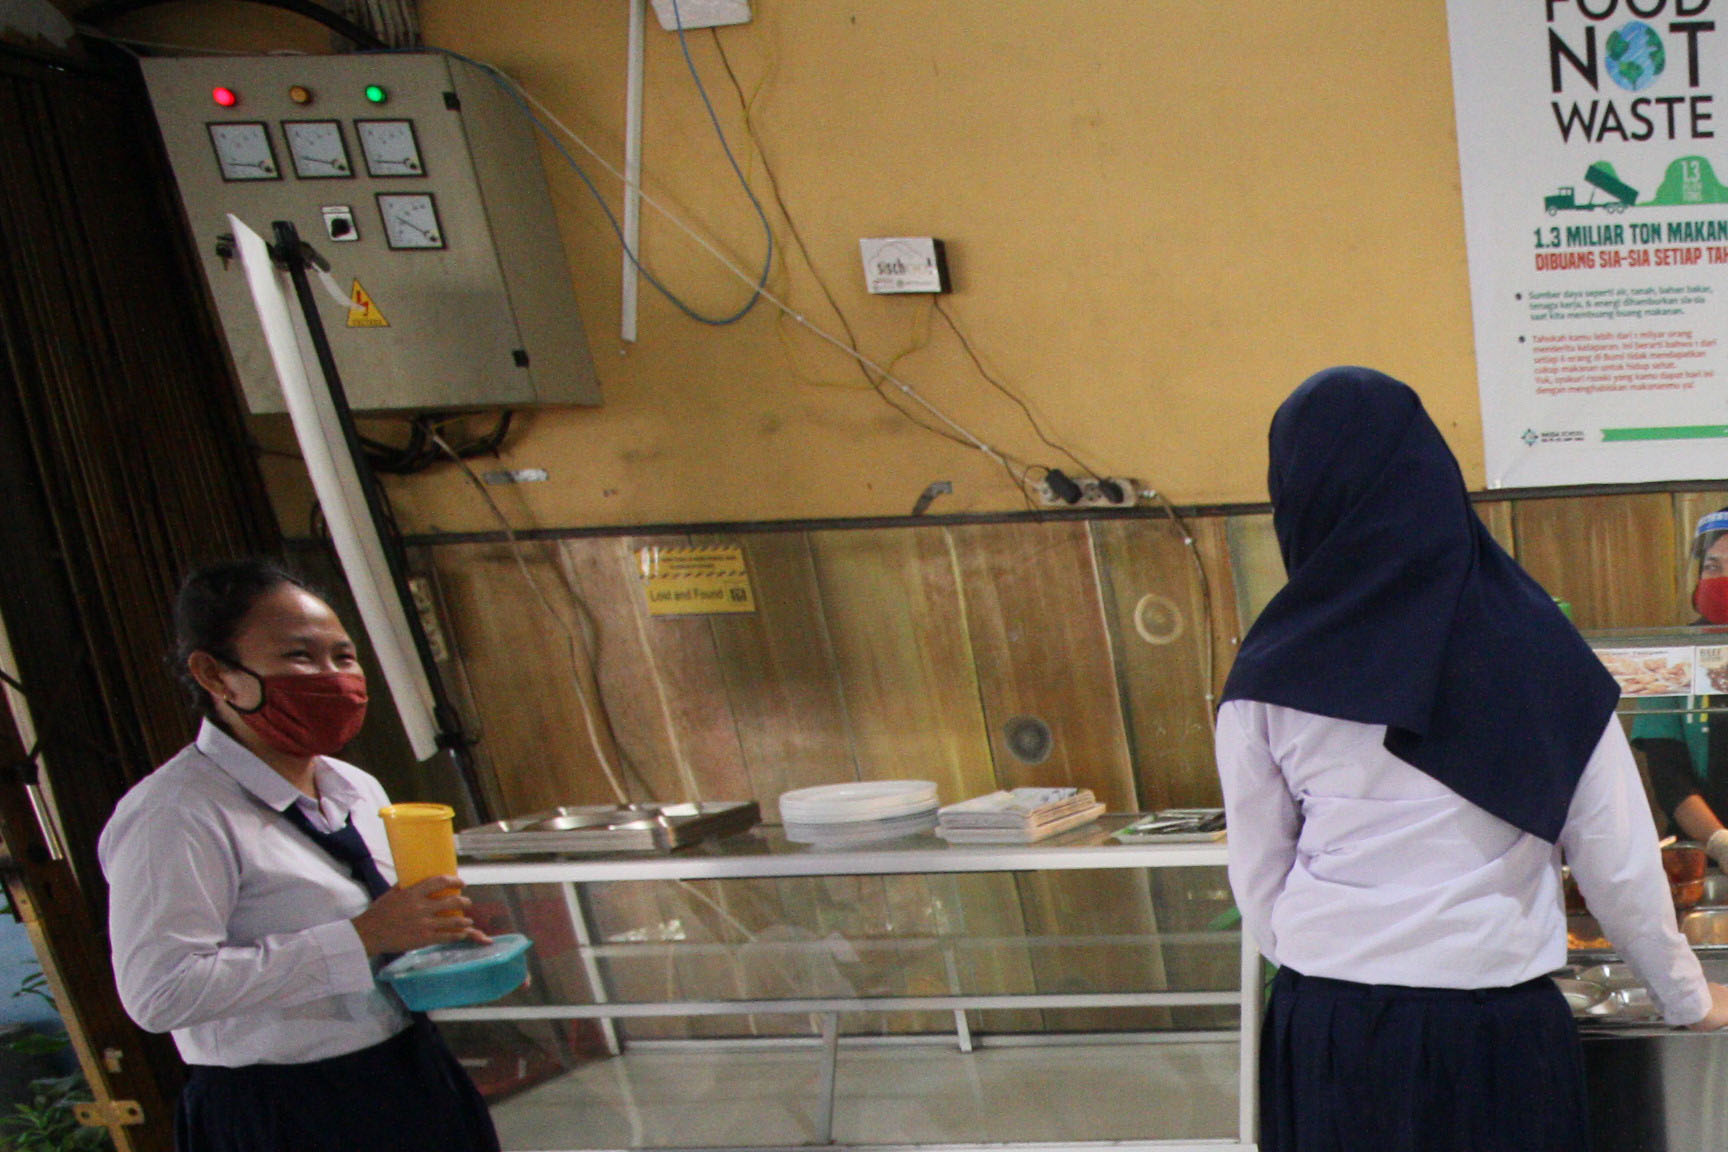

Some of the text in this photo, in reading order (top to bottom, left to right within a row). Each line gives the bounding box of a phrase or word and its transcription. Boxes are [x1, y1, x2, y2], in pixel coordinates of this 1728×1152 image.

[1551, 95, 1715, 144] WASTE
[1533, 226, 1561, 249] 1.3
[1566, 223, 1625, 248] MILIAR
[1629, 222, 1662, 245] TON
[1535, 249, 1596, 272] DIBUANG
[1599, 248, 1651, 269] SIA-SIA
[1654, 246, 1702, 266] SETIAP
